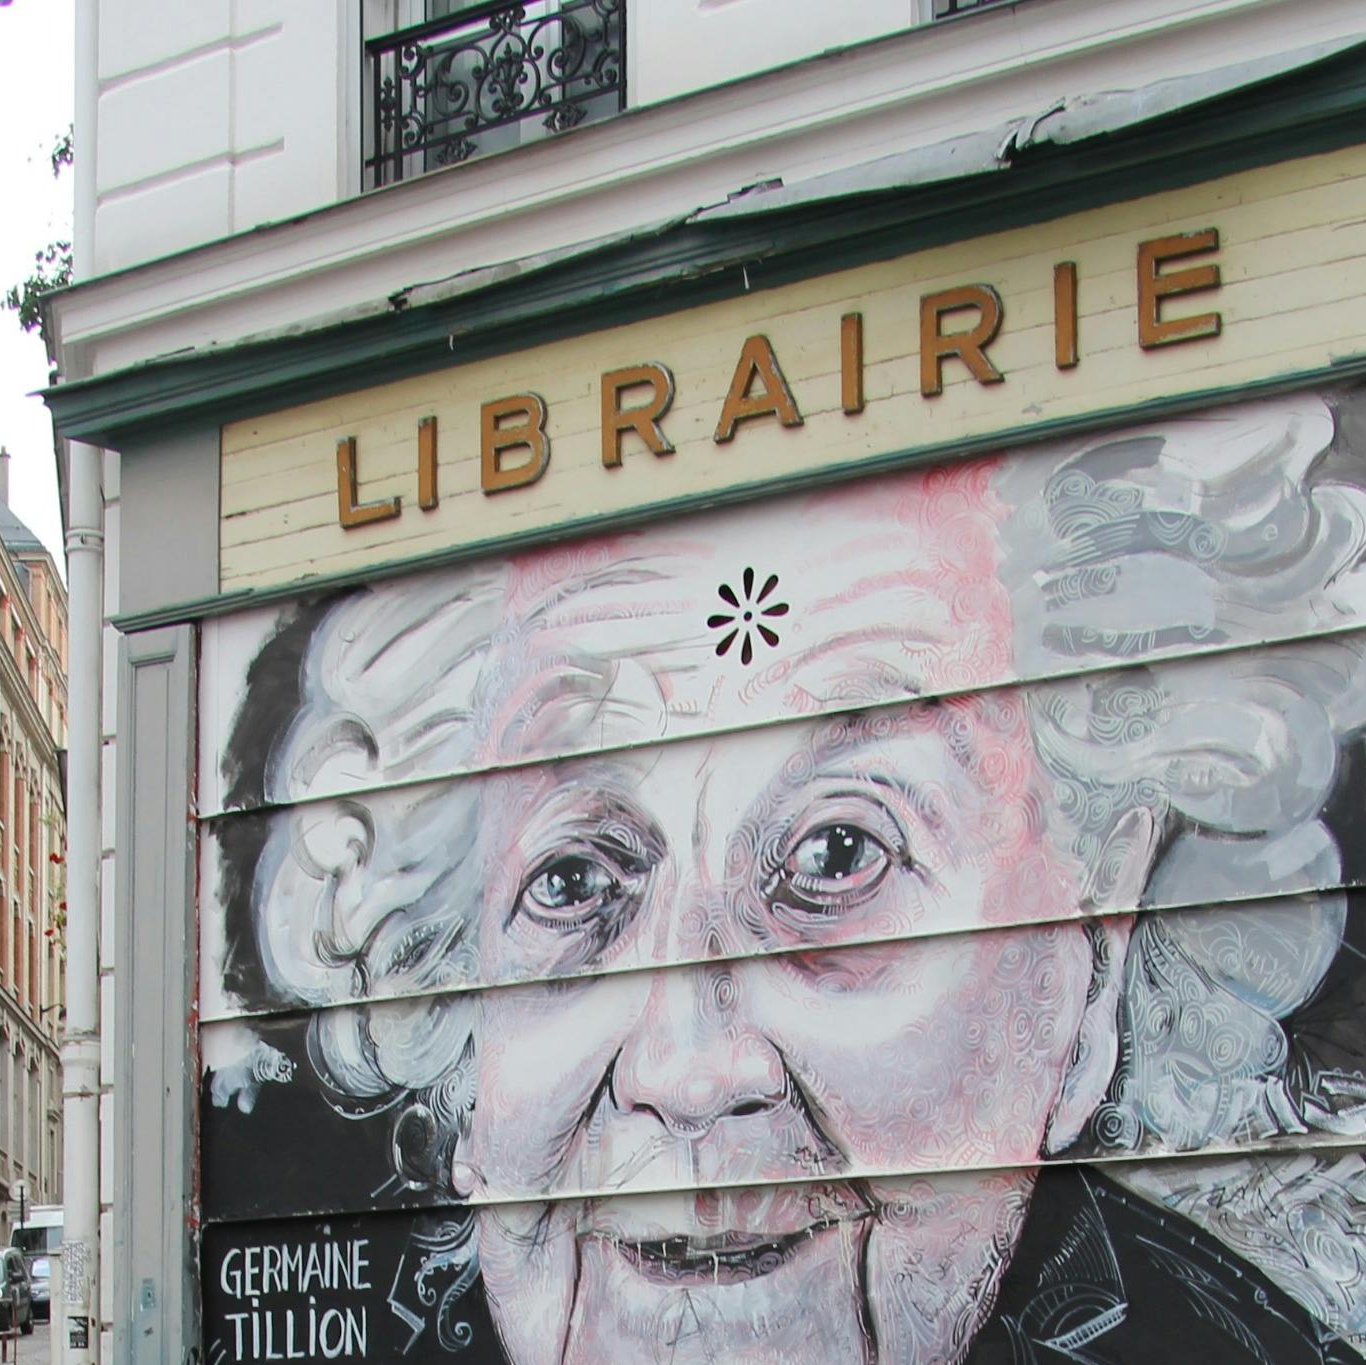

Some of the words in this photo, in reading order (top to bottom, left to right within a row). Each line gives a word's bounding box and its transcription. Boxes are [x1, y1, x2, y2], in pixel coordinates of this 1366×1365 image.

[336, 227, 1221, 530] LIBRAIRIE
[220, 1225, 371, 1297] GERMAINE
[224, 1298, 367, 1361] TILLION
